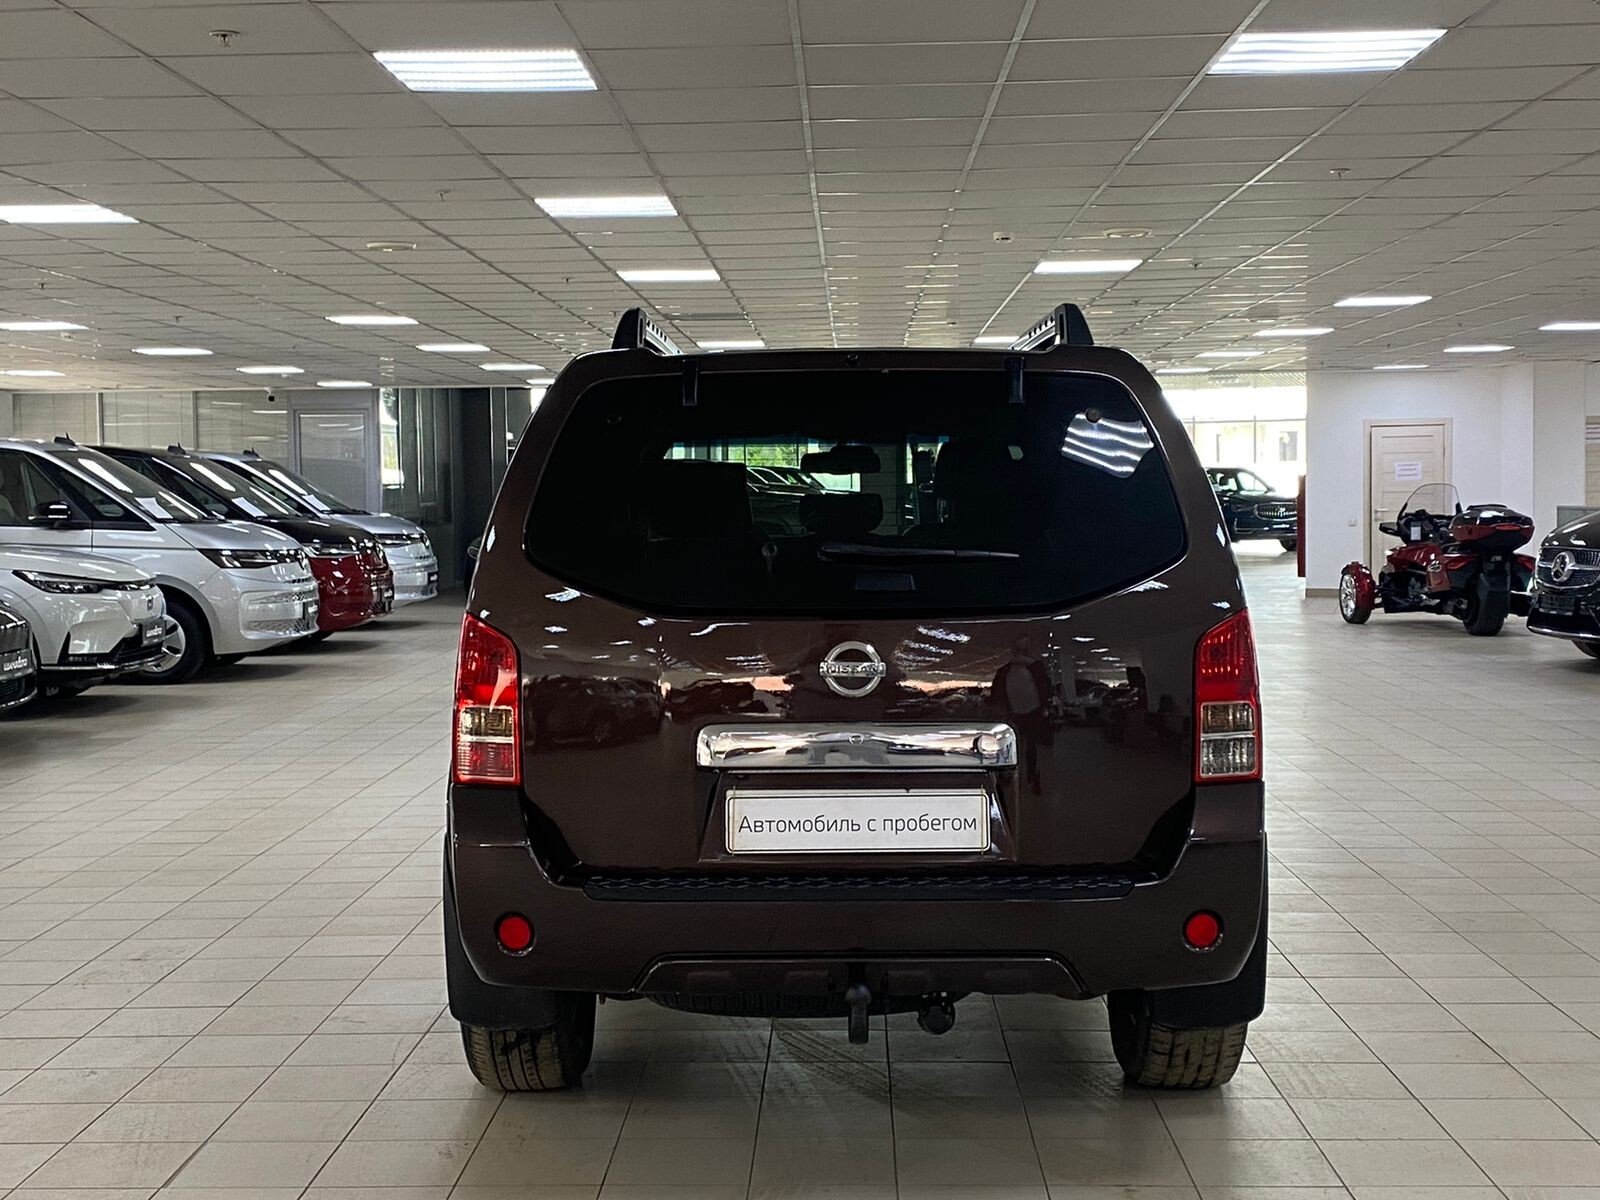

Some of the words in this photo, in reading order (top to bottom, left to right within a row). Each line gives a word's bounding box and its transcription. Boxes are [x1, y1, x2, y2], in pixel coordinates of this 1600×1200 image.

[825, 663, 880, 675] NISSAN
[738, 814, 861, 833] Автомобиль
[866, 818, 877, 832] с
[882, 813, 978, 835] пробегом
